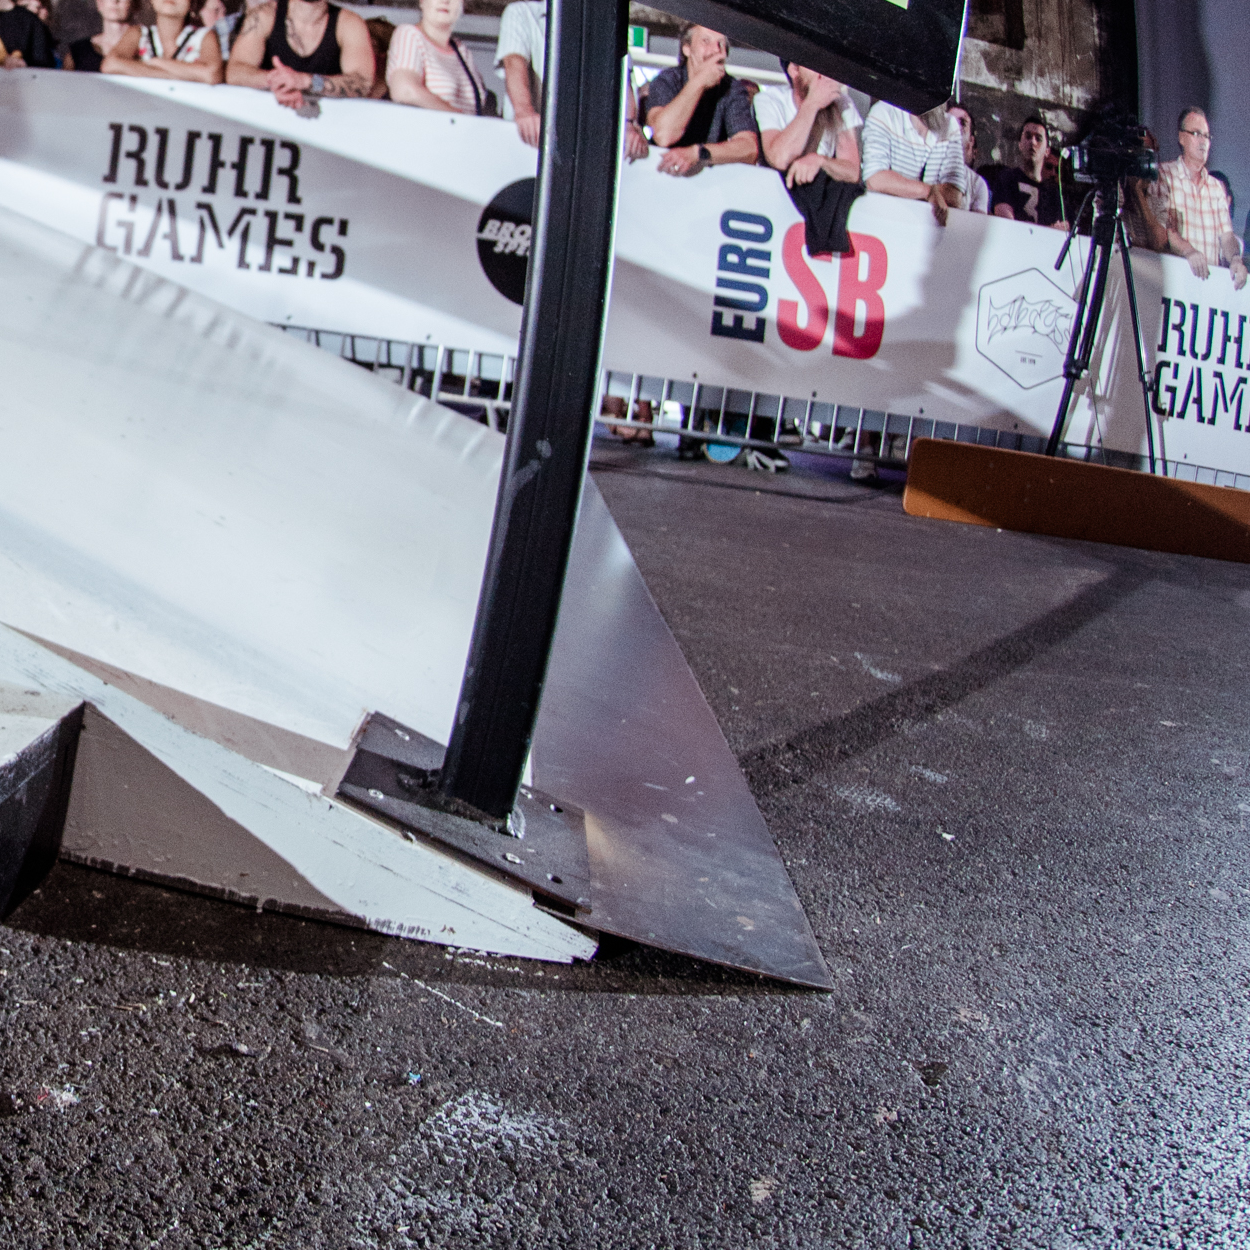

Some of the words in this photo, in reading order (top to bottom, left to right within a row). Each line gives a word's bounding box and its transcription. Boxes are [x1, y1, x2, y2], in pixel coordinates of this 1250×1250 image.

[102, 122, 302, 205] RUHR
[96, 192, 349, 280] GAMES
[710, 209, 773, 343] EURO
[776, 222, 888, 360] SB
[1157, 296, 1250, 371] RUH
[1151, 360, 1250, 433] GAM
